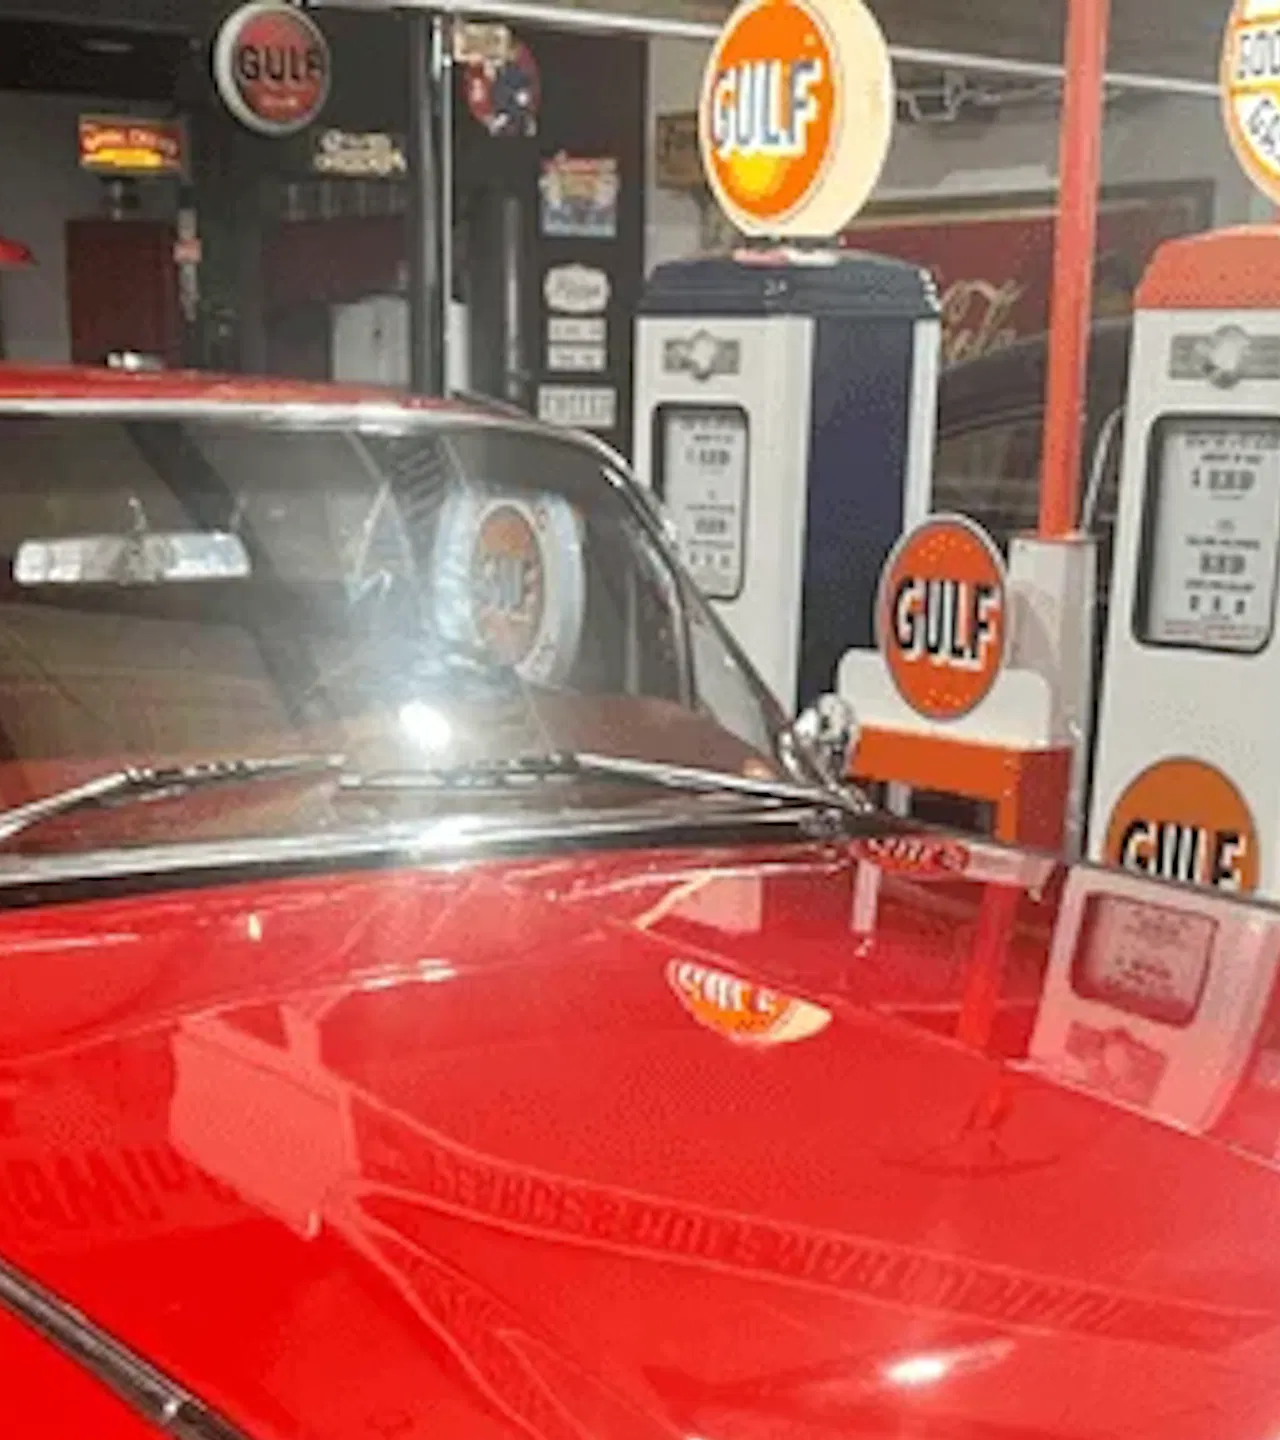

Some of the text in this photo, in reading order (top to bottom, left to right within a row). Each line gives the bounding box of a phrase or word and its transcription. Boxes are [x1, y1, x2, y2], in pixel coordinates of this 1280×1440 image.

[239, 44, 324, 82] GULF
[708, 60, 822, 155] GULF
[893, 573, 1003, 671] GULF
